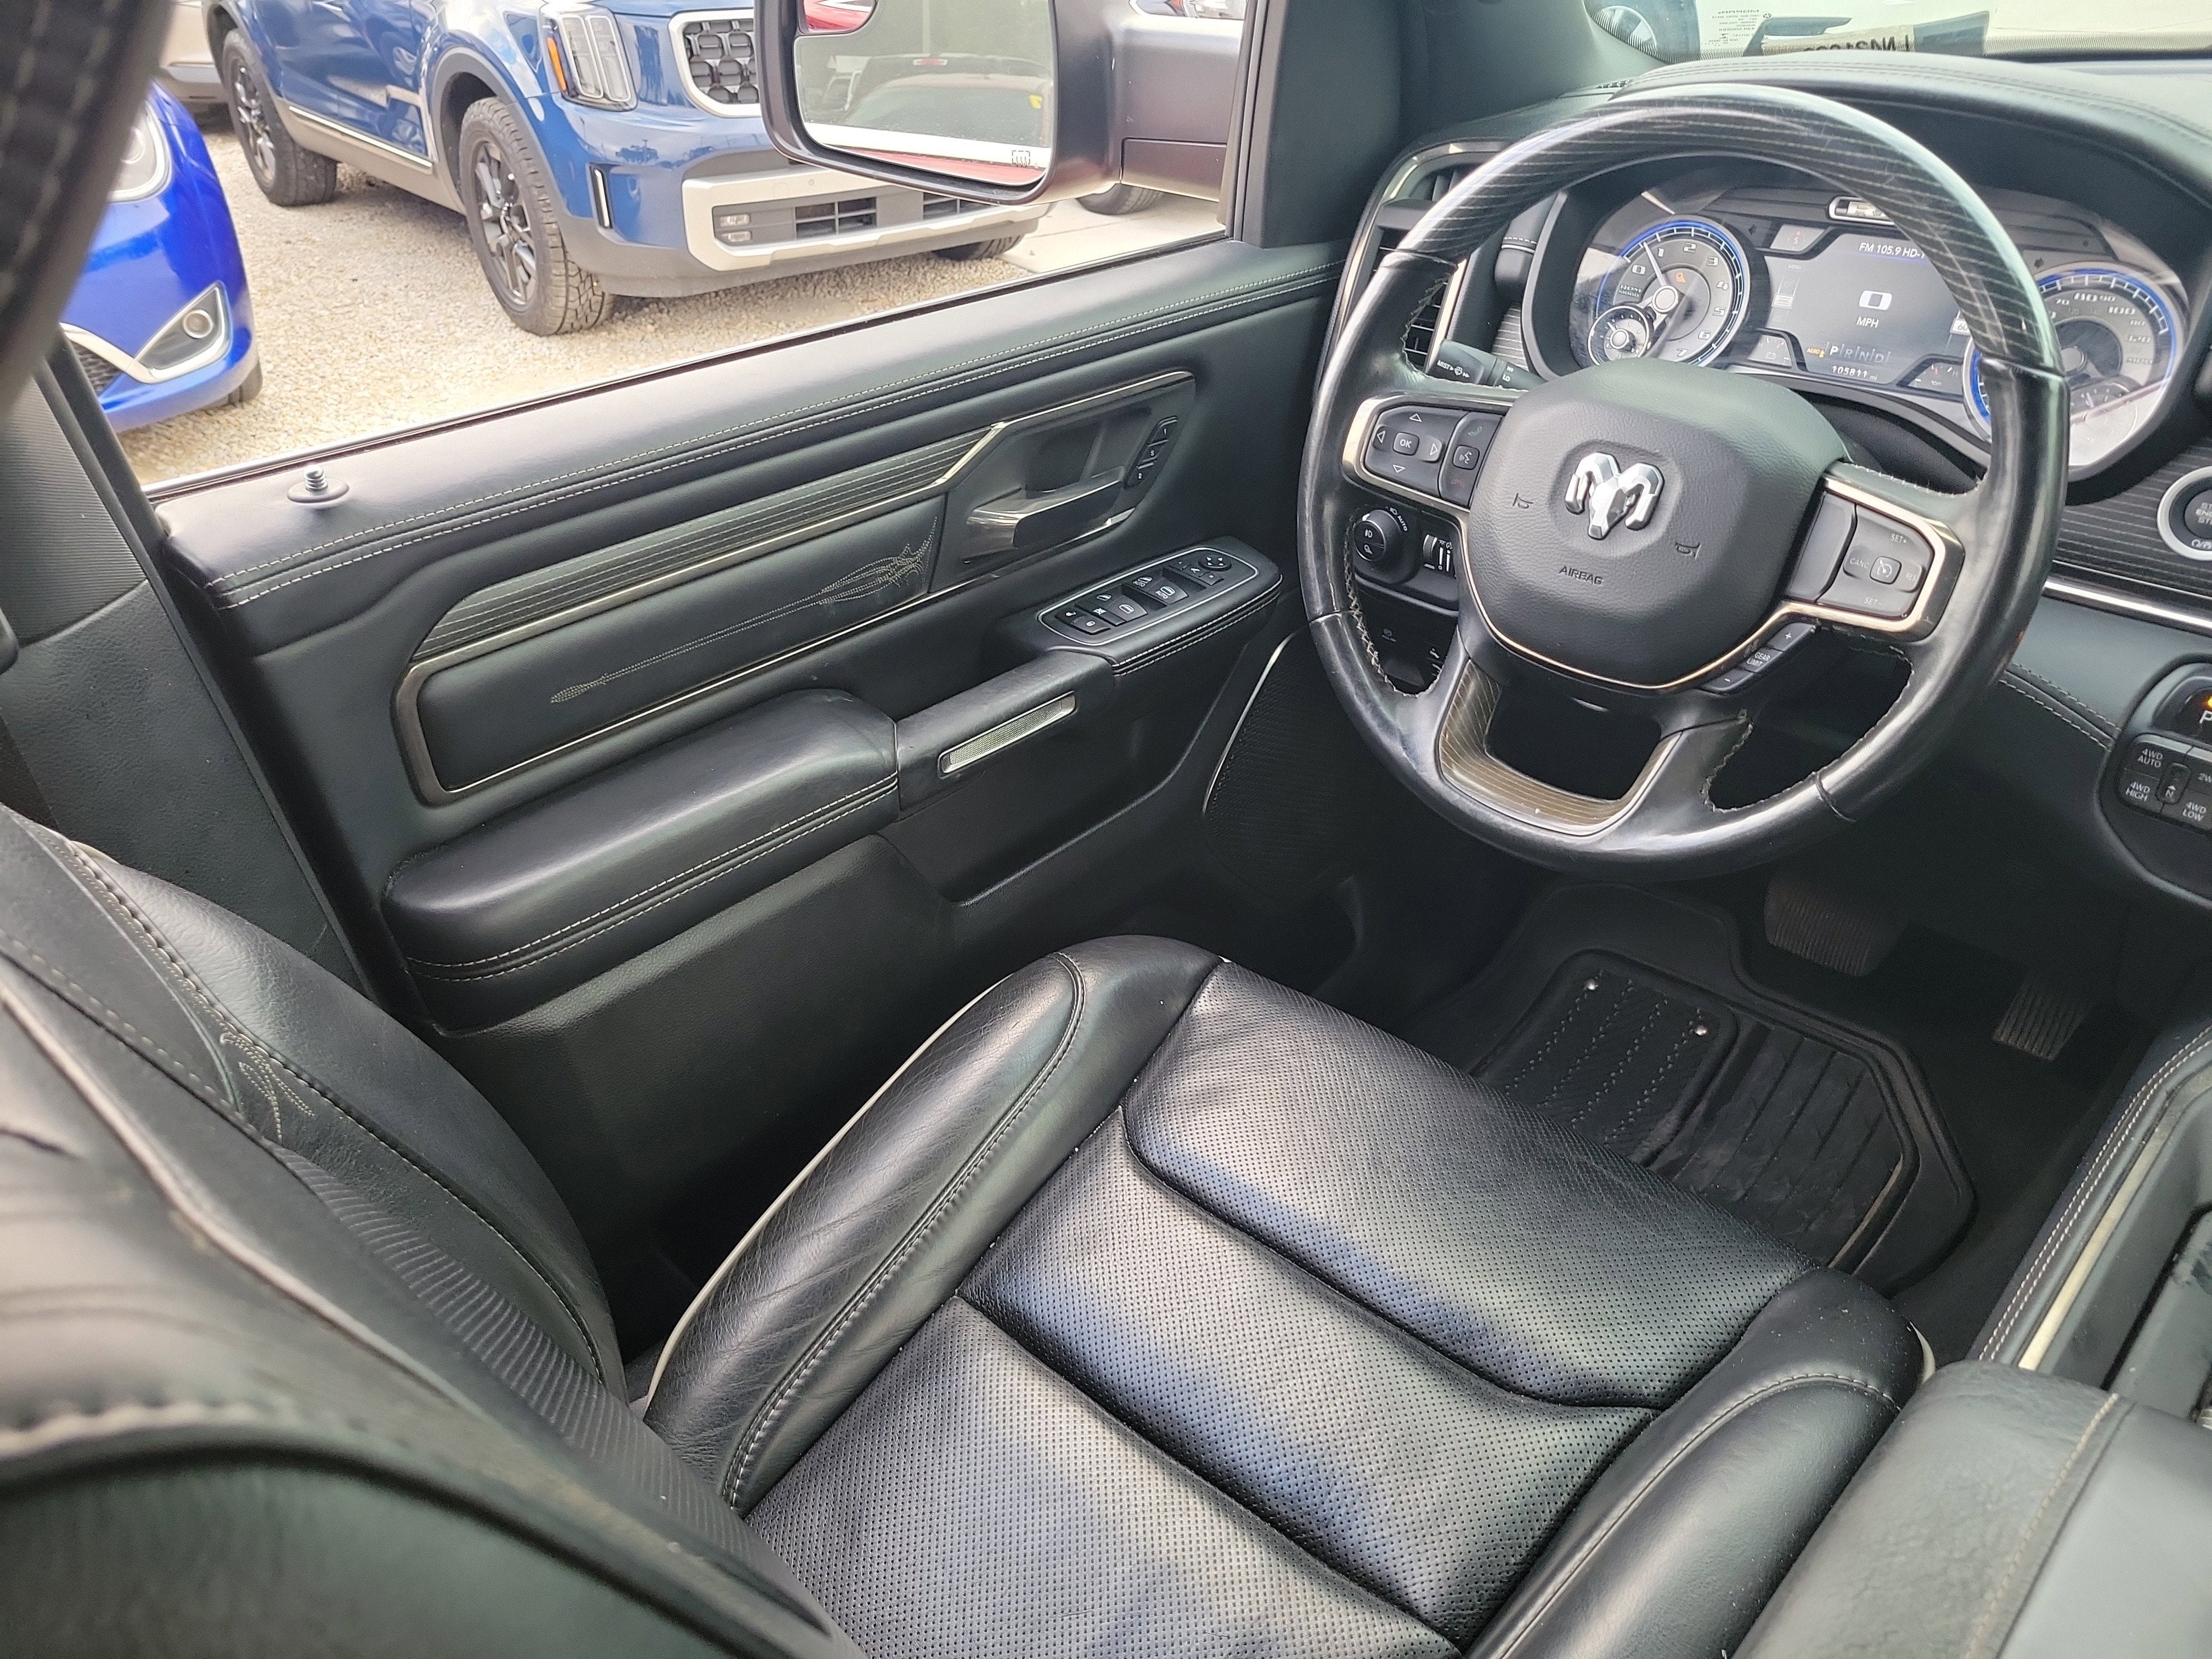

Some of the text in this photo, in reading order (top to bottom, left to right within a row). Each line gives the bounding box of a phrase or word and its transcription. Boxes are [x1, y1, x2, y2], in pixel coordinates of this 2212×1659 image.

[1658, 248, 1664, 257] 1
[1683, 243, 1696, 252] 2
[1859, 242, 1874, 252] FM
[1877, 245, 1901, 255] 105.9
[1706, 256, 1718, 266] 3
[1632, 264, 1645, 274] 0
[1620, 284, 1641, 293] RPM
[1717, 281, 1729, 290] 4
[1859, 290, 1892, 311] 0
[2074, 292, 2097, 301] 80
[1713, 307, 1726, 315] 5
[2108, 306, 2136, 315] 100
[1857, 317, 1879, 328] MPH
[1698, 331, 1711, 340] 6
[1677, 348, 1689, 357] 7
[1830, 345, 1884, 363] P R N D
[1832, 365, 1867, 379] 105811
[1400, 439, 1412, 449] OK
[1397, 515, 1408, 532] AUTO
[1850, 557, 1870, 568] CANC
[1558, 566, 1603, 585] AIRBAG
[1905, 572, 1917, 582] RES
[1755, 651, 1770, 662] GEAR
[2142, 748, 2163, 760] 4WD
[2137, 755, 2161, 768] AUTO
[2198, 773, 2212, 783] 2W
[2130, 782, 2151, 793] 4WD
[2126, 788, 2148, 801] HIGH
[2166, 789, 2174, 798] N
[2186, 802, 2207, 814] 4WD
[2183, 809, 2204, 821] LOW
